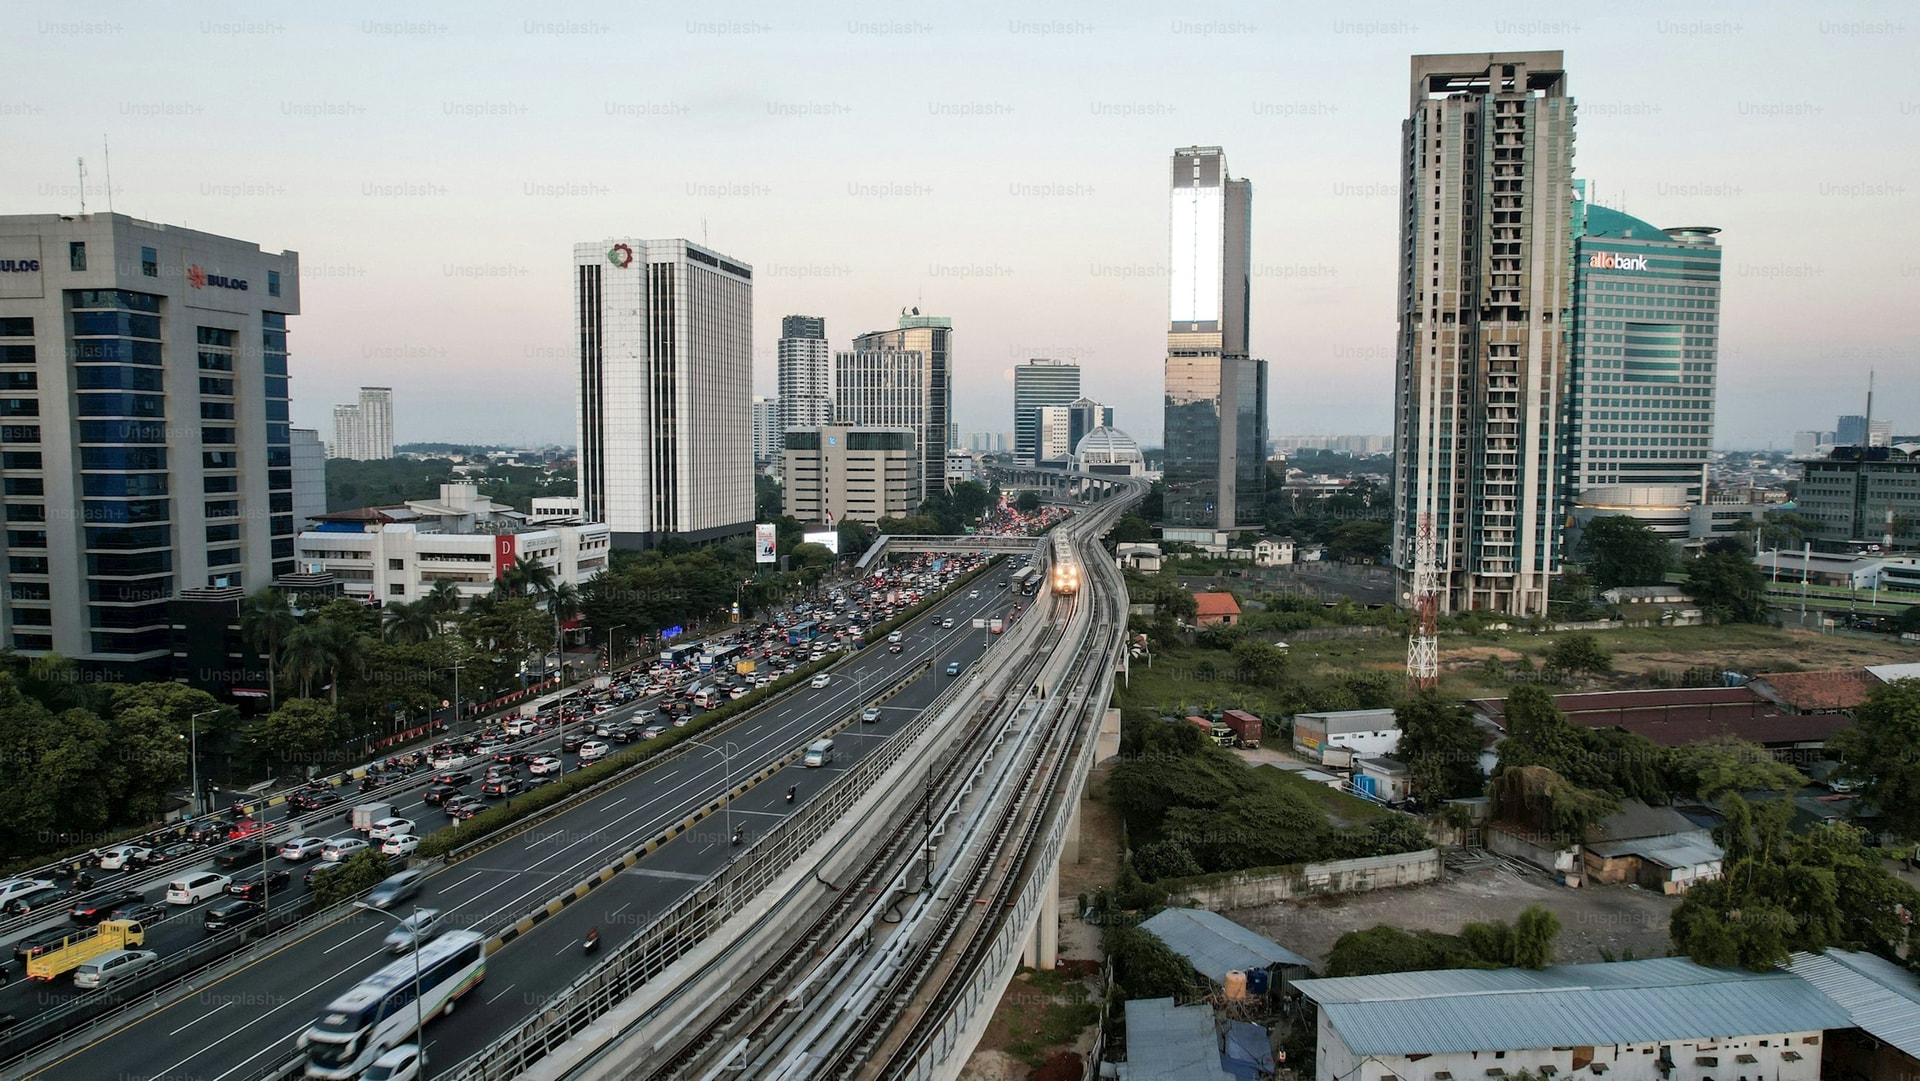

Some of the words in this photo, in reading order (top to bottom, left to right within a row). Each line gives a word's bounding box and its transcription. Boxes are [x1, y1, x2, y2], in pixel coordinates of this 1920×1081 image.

[0, 259, 40, 272] ULOG
[1590, 252, 1648, 271] allobank
[208, 274, 248, 291] BULOG
